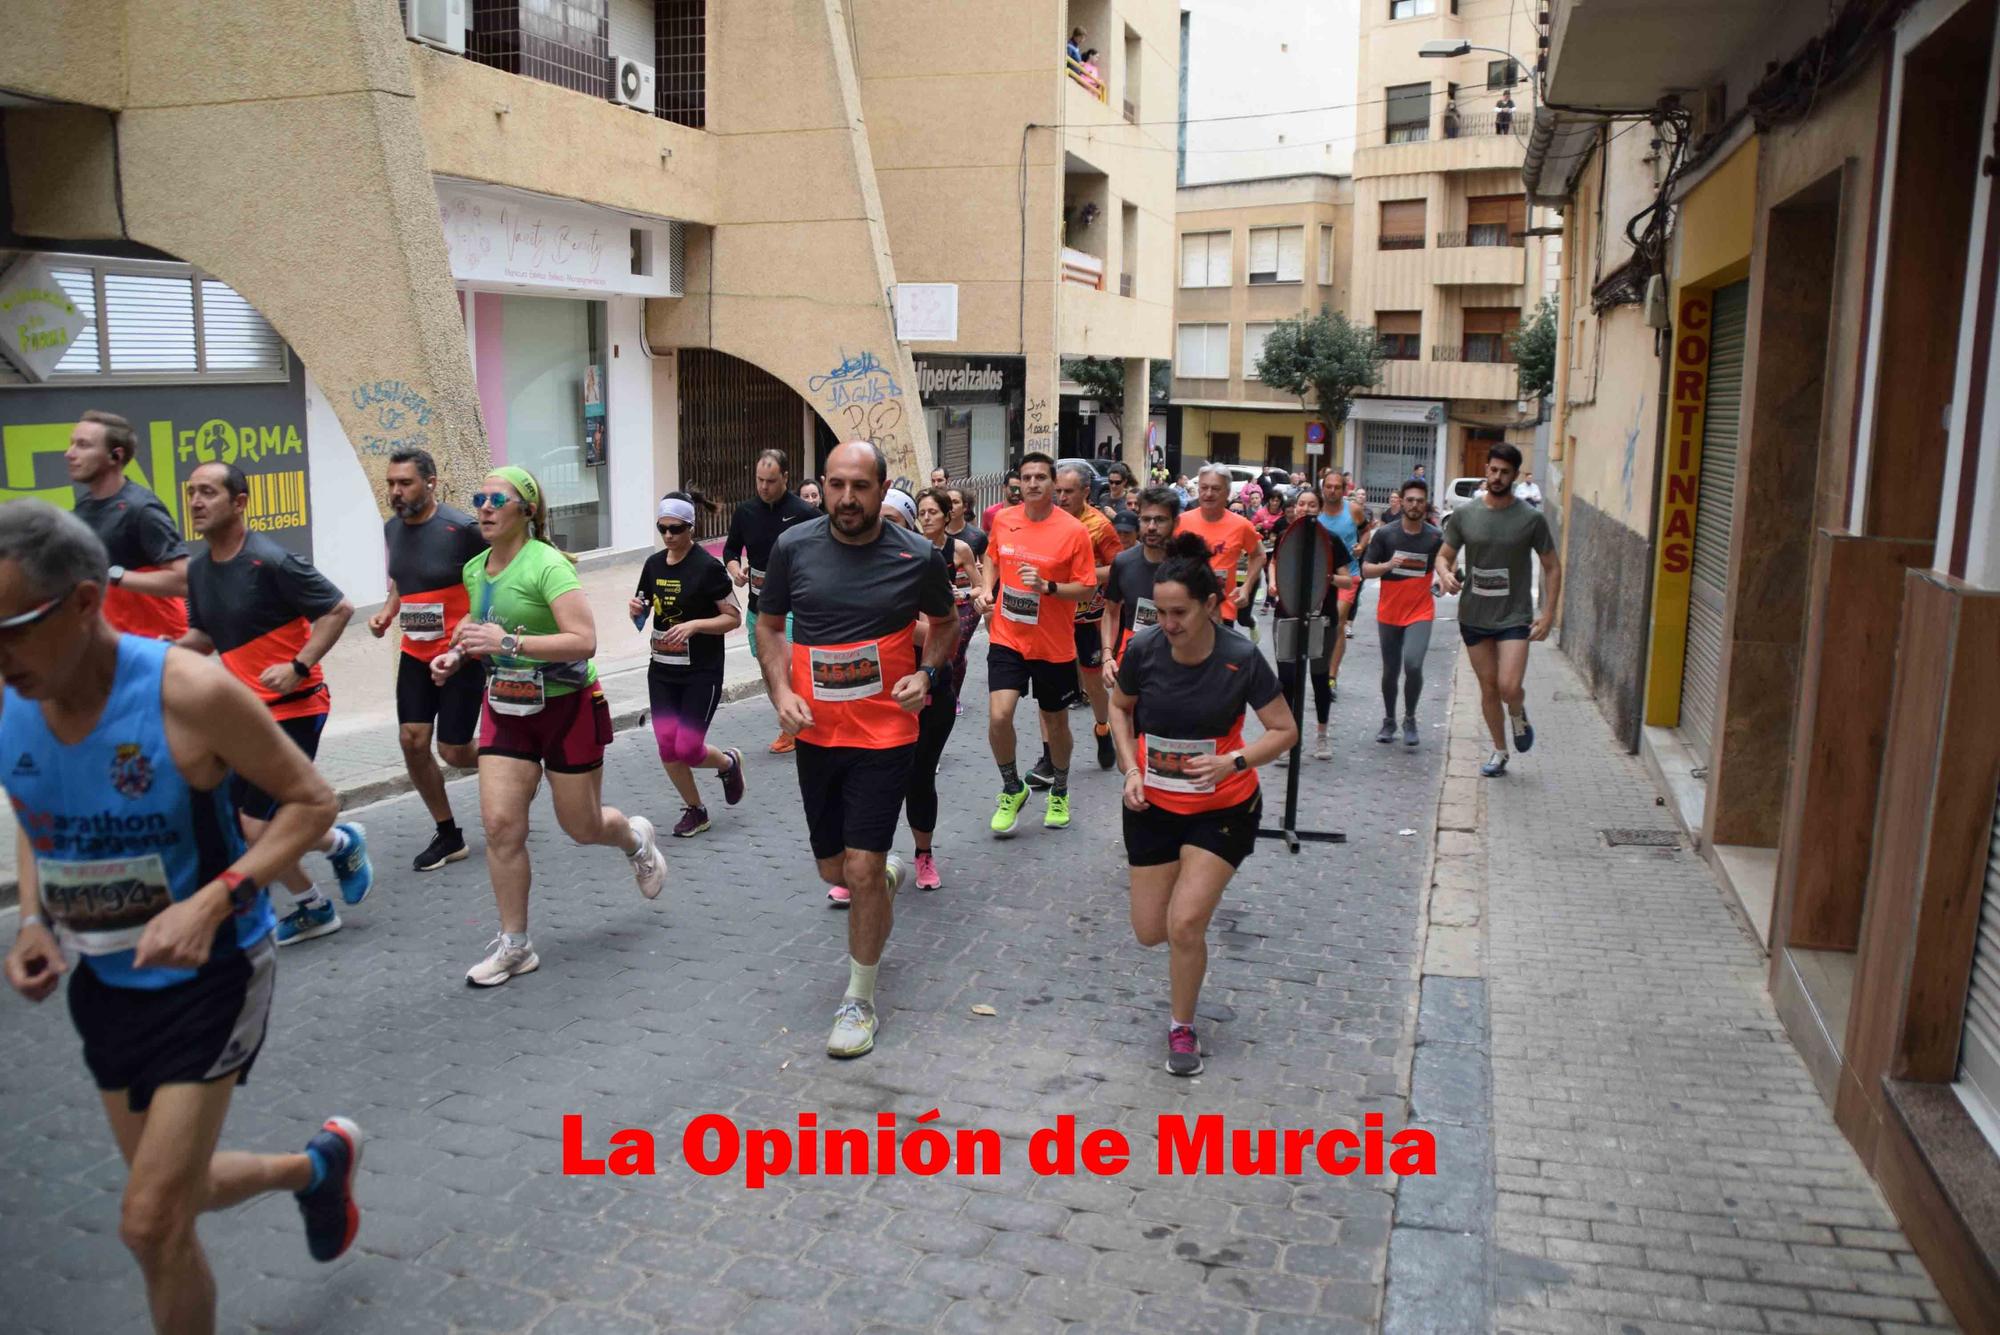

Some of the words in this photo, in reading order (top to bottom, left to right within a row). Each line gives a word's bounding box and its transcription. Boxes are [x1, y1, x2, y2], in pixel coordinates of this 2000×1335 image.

[178, 418, 303, 465] FORMA
[1663, 299, 1709, 573] CORTINAS
[28, 808, 167, 835] Marathon
